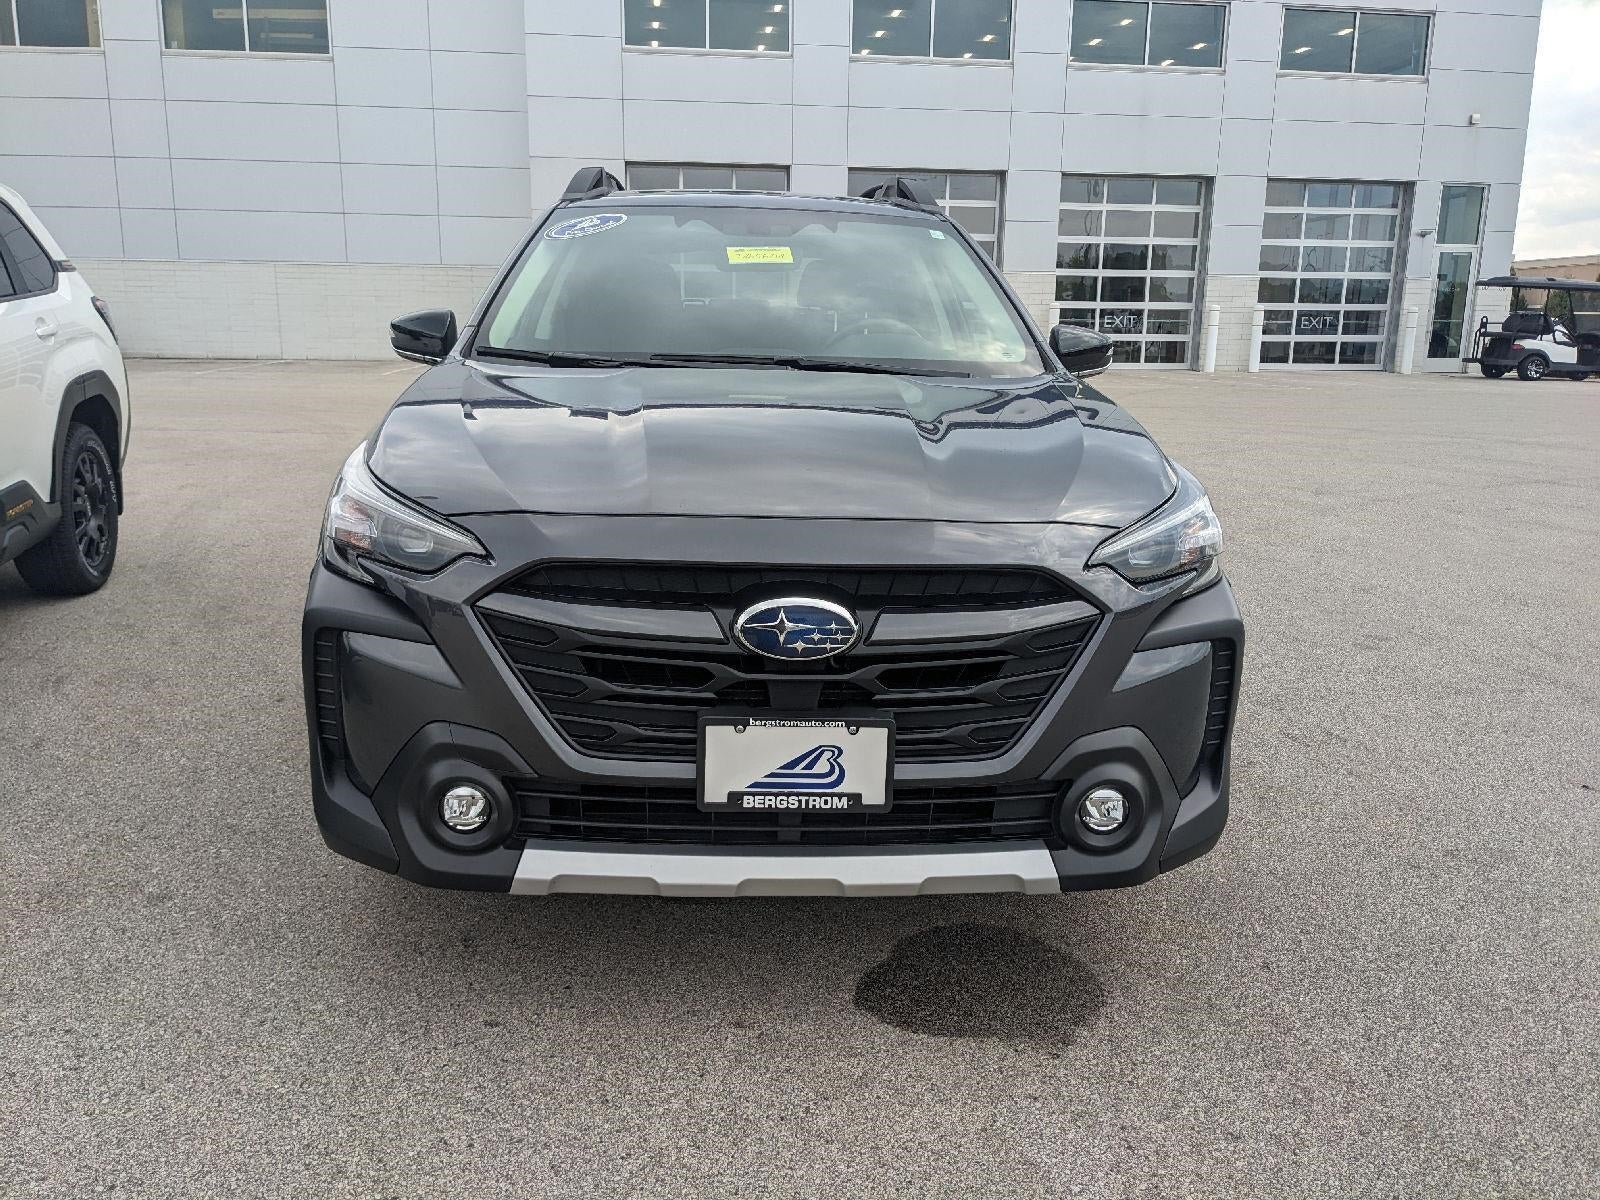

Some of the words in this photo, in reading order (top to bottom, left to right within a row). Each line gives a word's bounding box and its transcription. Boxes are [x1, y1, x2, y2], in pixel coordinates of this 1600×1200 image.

[1104, 316, 1137, 328] EXIT
[1301, 316, 1333, 328] EXIT
[749, 718, 846, 728] bergstromauto.com
[742, 795, 848, 809] BERGSTROM
